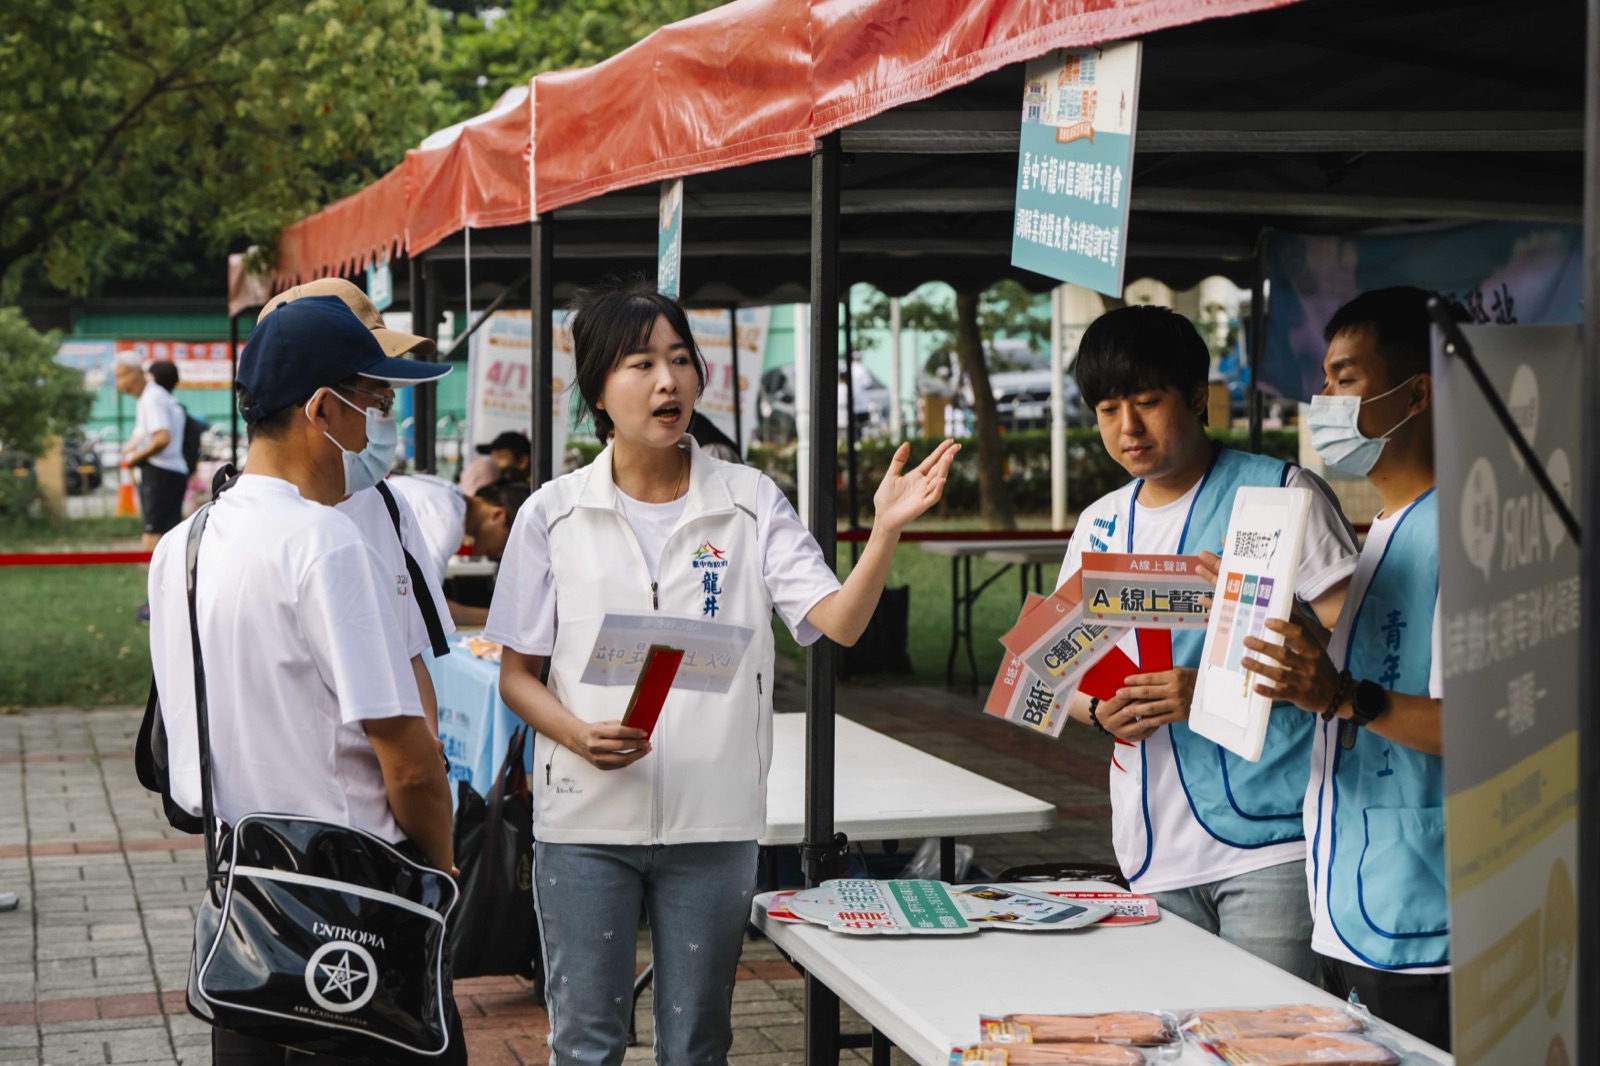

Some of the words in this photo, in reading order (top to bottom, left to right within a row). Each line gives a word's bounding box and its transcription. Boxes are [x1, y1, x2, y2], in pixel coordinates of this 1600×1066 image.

[1021, 151, 1123, 208] 臺中市龍井區調解委員會
[1129, 559, 1187, 573] A線上聲請
[702, 570, 722, 618] 龍井
[1092, 588, 1111, 608] A
[1022, 680, 1054, 726] B紙
[312, 921, 386, 950] ENTROPIA
